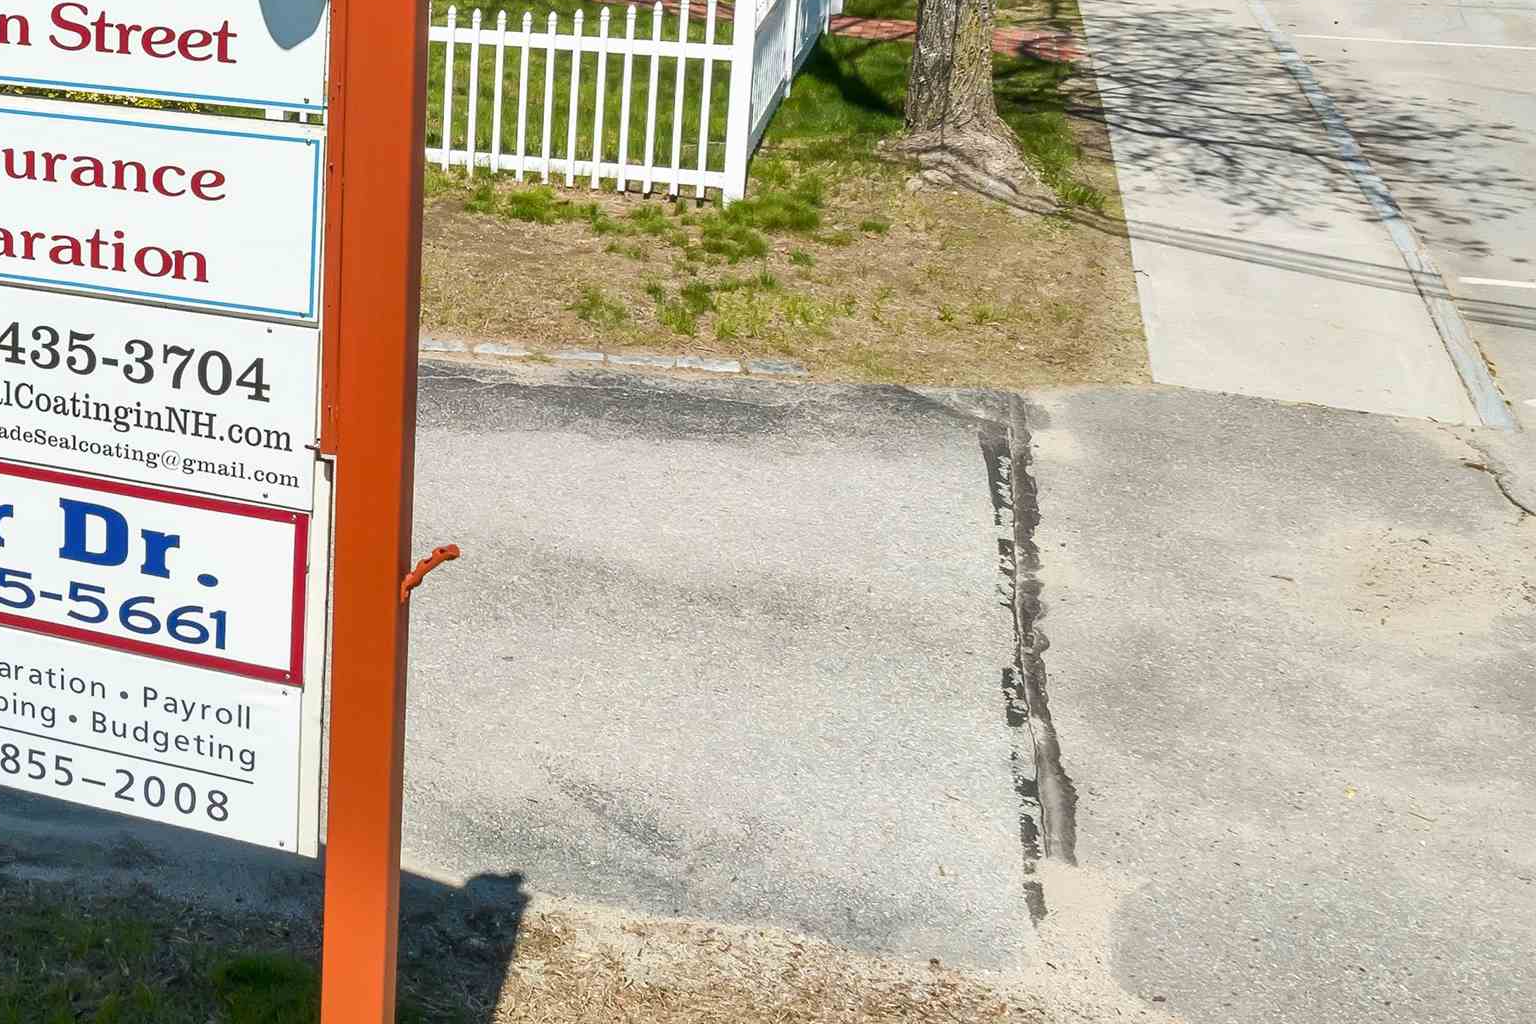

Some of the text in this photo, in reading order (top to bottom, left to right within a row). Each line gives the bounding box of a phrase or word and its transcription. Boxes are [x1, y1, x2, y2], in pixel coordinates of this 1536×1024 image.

[49, 2, 237, 64] Street
[59, 497, 219, 587] Dr.
[143, 687, 251, 731] Payroll
[91, 710, 256, 771] Budgeting
